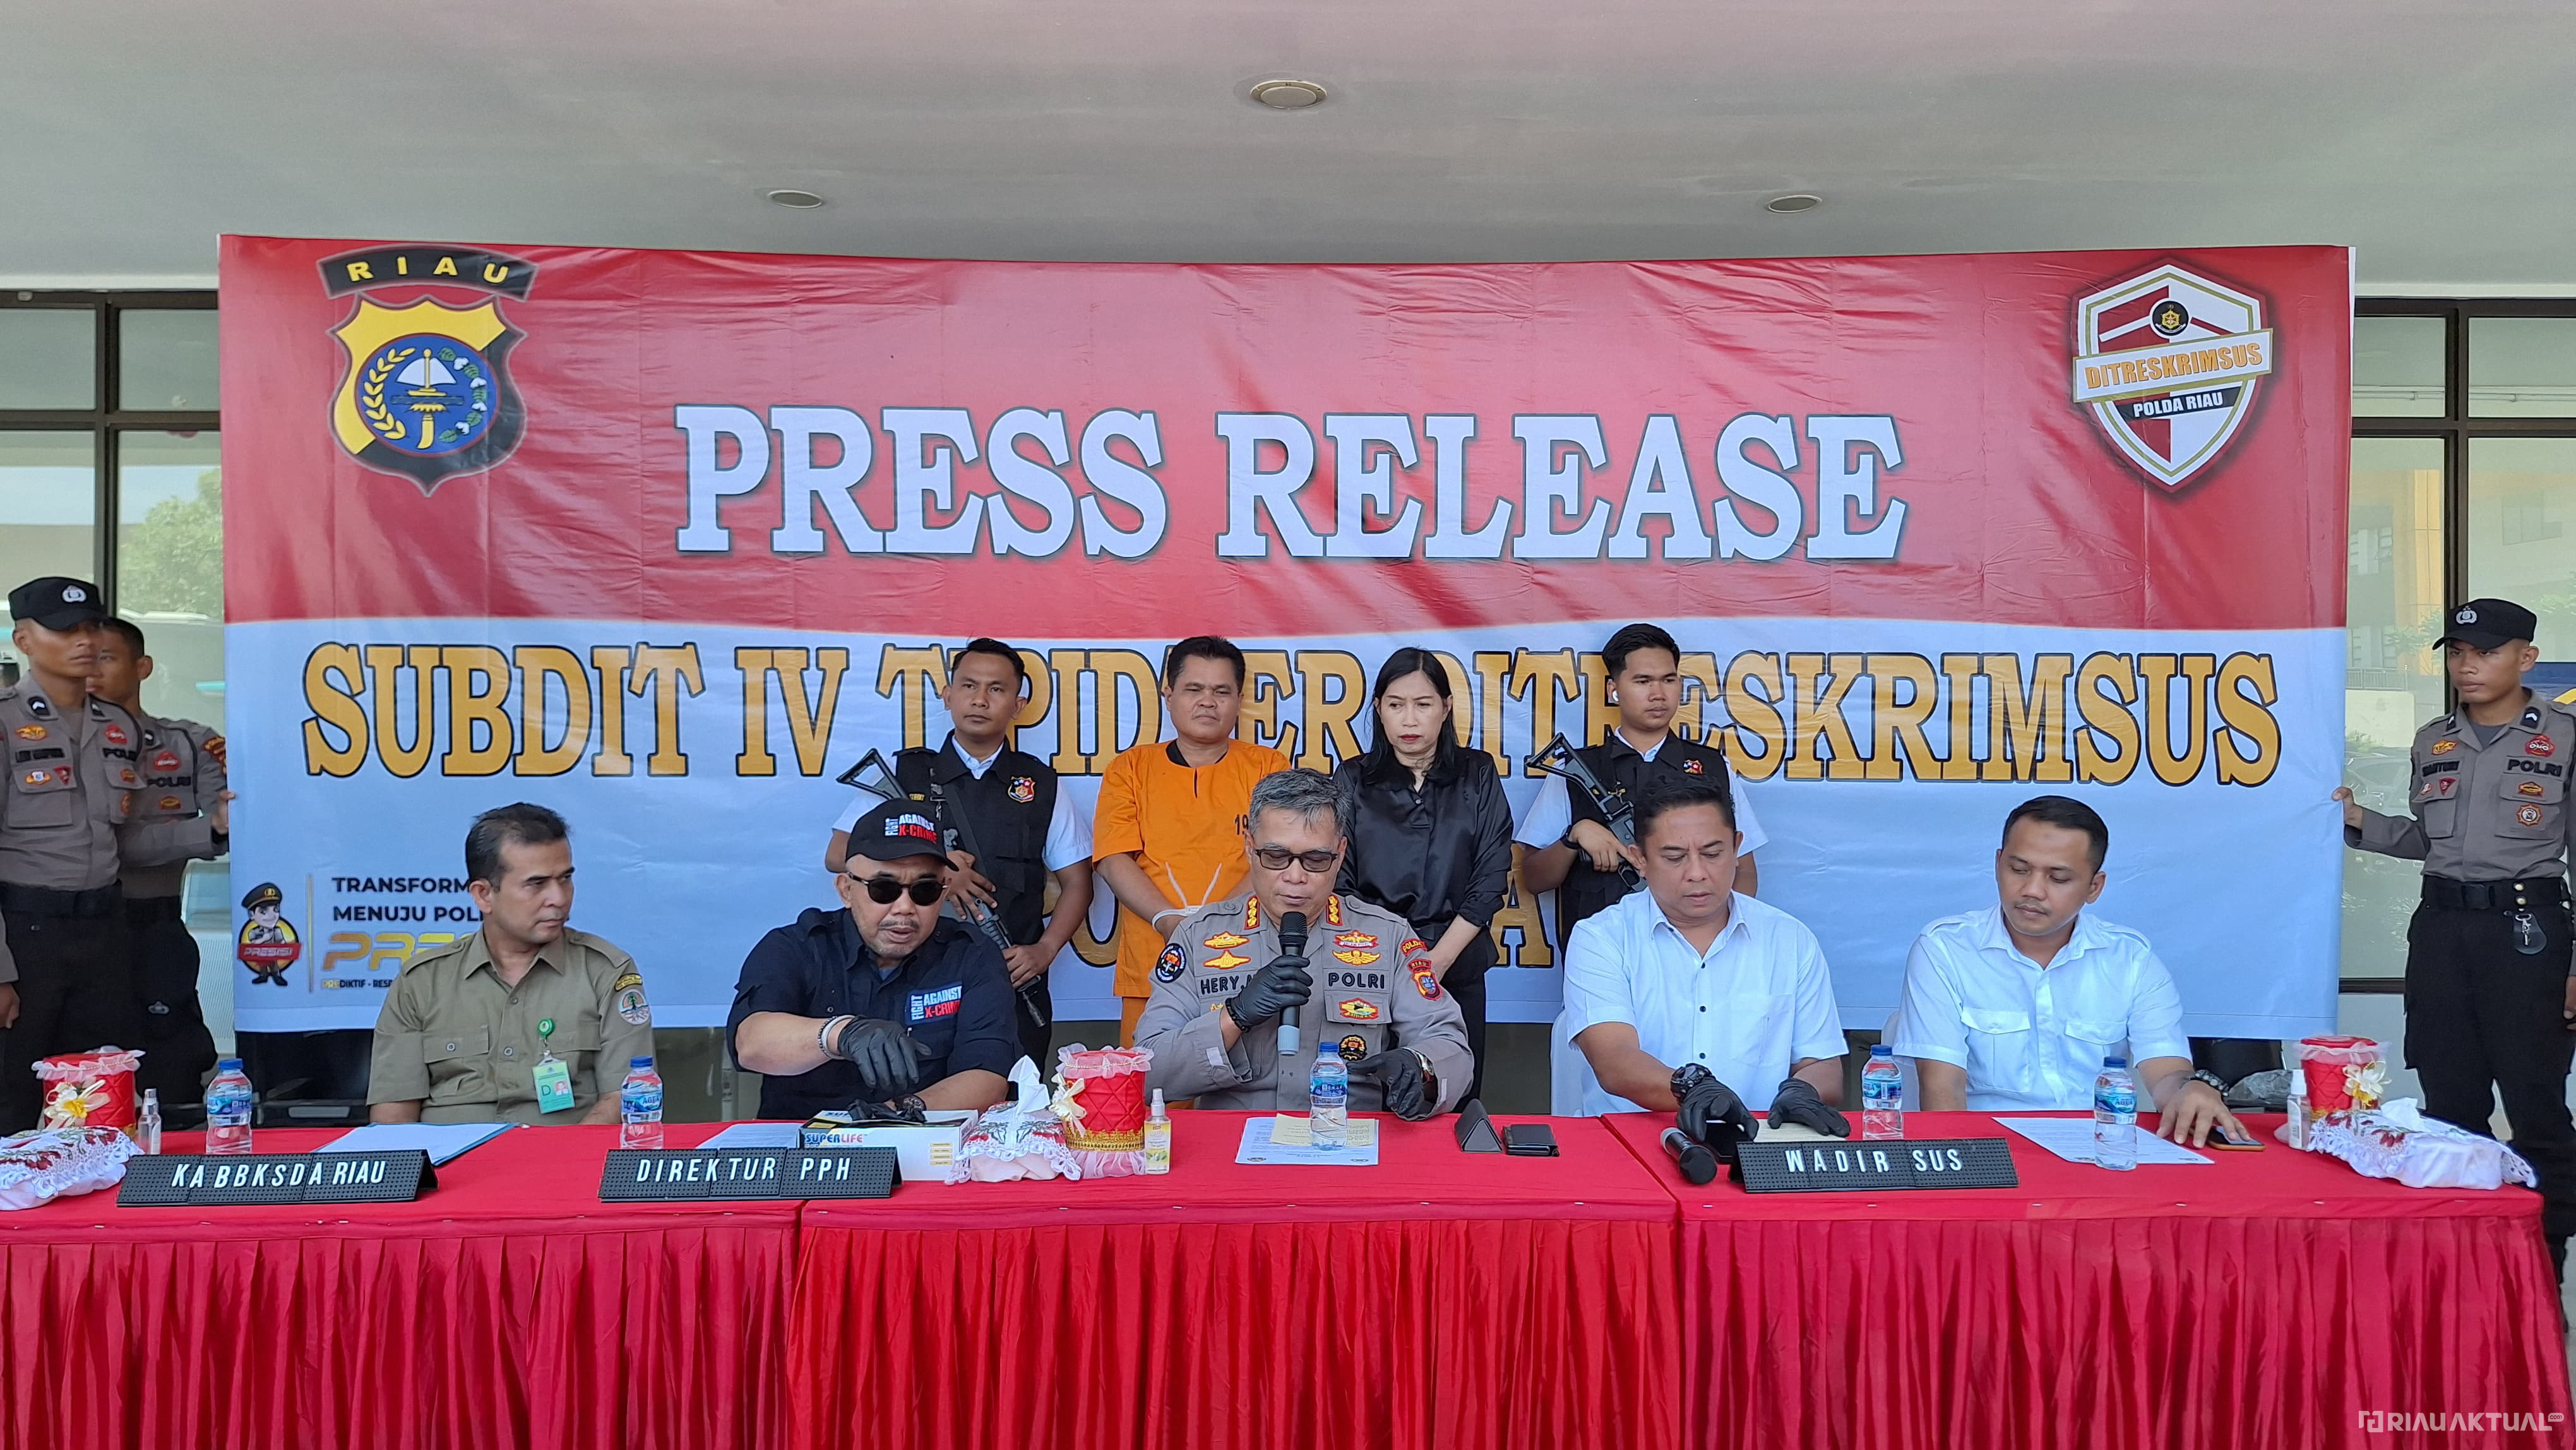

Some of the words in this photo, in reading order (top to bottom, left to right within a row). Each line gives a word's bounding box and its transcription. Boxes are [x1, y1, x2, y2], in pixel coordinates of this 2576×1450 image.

[346, 256, 508, 284] RIAU
[2085, 343, 2262, 389] DITRESKRIMSUS
[2133, 397, 2185, 417] POLDA
[2186, 392, 2223, 410] RIAU
[675, 405, 1167, 559] PRESS
[1215, 412, 1906, 561] RELEASE
[301, 642, 705, 777] SUBDIT
[735, 647, 850, 777] IV
[2507, 759, 2562, 777] POLRI
[899, 813, 934, 831] AGAINST
[333, 906, 426, 921] MENUJU
[1328, 972, 1385, 989] POLRI
[910, 995, 924, 1021] FIGHT
[924, 985, 962, 1006] AGAINST
[806, 1134, 863, 1143] SUPERLIFE
[636, 1156, 776, 1182] DIREKTUR
[799, 1157, 850, 1181] PPH
[1785, 1149, 1890, 1173] WADIR
[1912, 1148, 1962, 1172] SUS
[171, 1163, 204, 1188] KA
[213, 1162, 322, 1188] BBKSDA
[332, 1160, 386, 1185] RIAU
